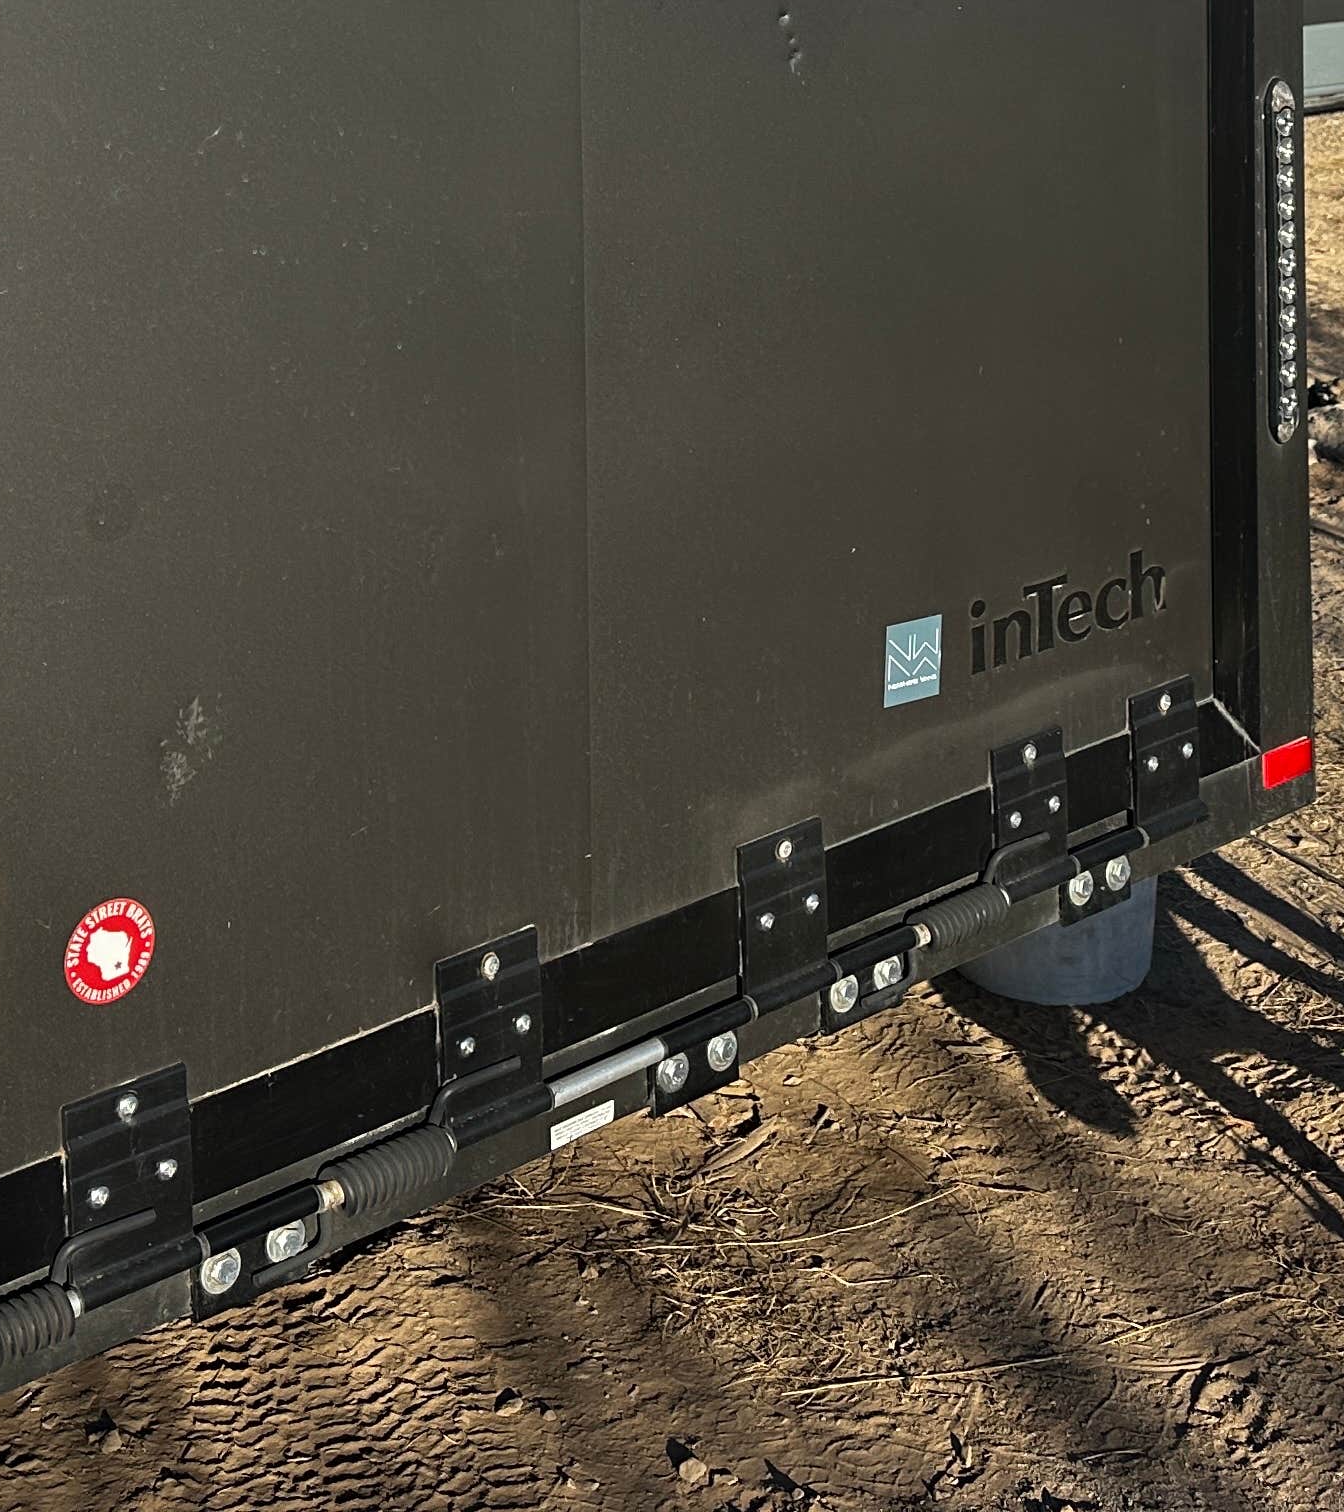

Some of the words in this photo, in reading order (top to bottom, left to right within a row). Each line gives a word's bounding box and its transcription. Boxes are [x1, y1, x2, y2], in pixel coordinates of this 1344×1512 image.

[970, 548, 1167, 675] inTech
[66, 926, 89, 968] STATE
[84, 901, 127, 929] STREET
[125, 903, 153, 939] BRATS
[72, 978, 131, 1001] ESTABLISHED
[130, 951, 151, 979] 1989
